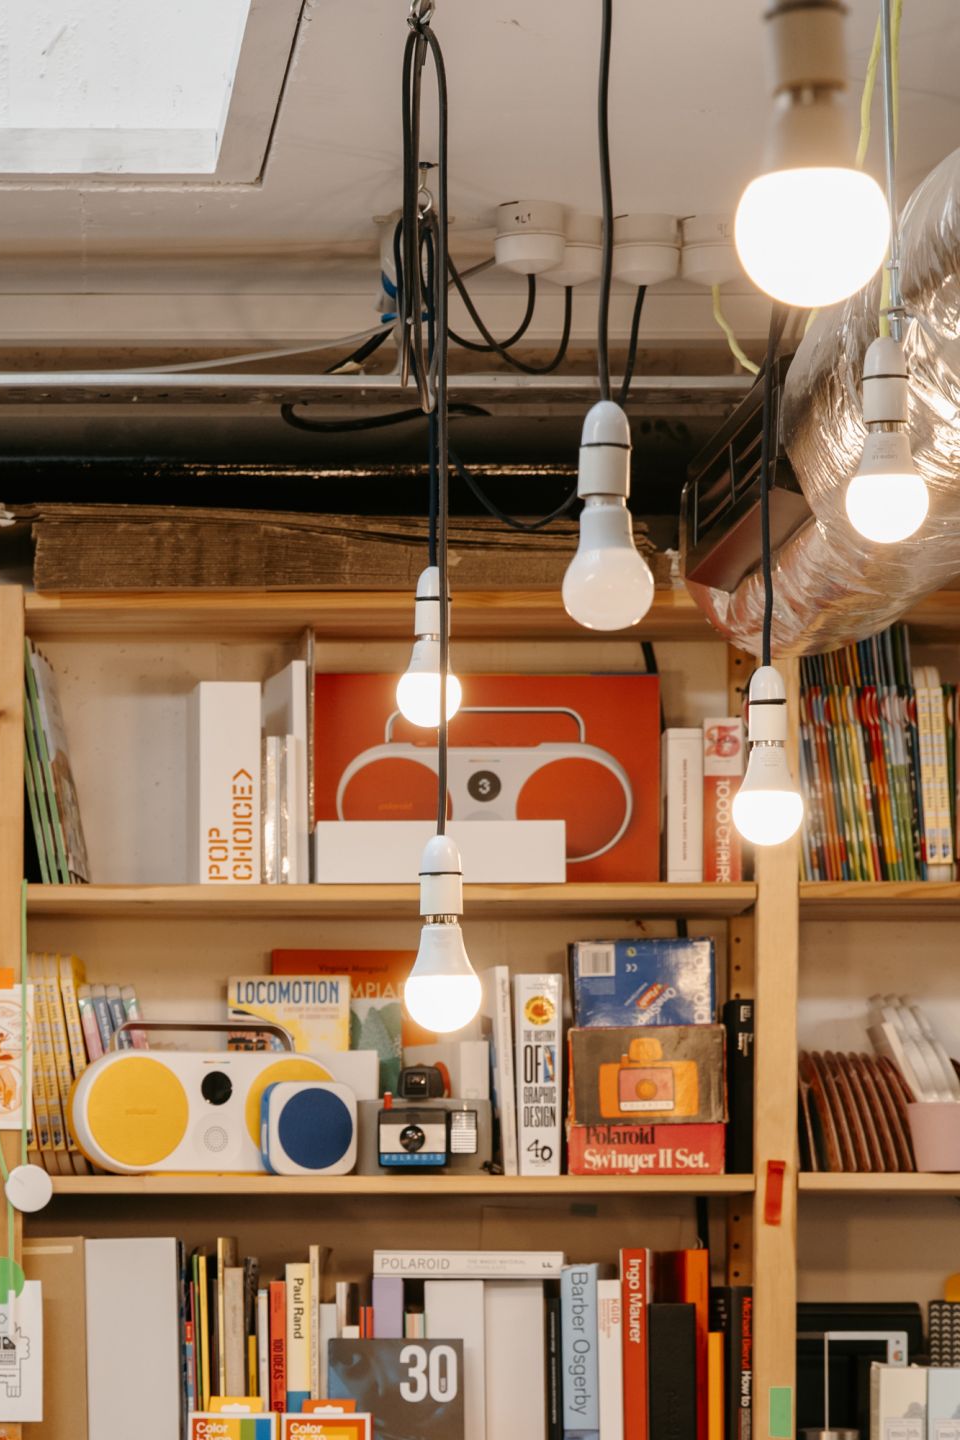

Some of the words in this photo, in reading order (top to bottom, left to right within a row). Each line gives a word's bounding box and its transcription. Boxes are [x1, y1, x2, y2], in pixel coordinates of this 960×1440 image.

[478, 778, 491, 794] 3
[715, 780, 730, 824] 1000
[208, 828, 228, 880] POP
[236, 980, 339, 1004] LOCOMOTION
[524, 1045, 541, 1083] OF
[524, 1087, 556, 1104] GRAPHIC
[524, 1106, 556, 1127] DESIGN
[586, 1126, 655, 1145] Polaroid
[584, 1148, 656, 1172] Swinger
[659, 1148, 672, 1168] II
[675, 1148, 710, 1168] Set.
[381, 1258, 451, 1270] POLAROID
[626, 1259, 642, 1289] Ingo
[293, 1278, 304, 1304] Paul
[570, 1272, 589, 1334] Barber
[293, 1308, 304, 1339] Rand
[610, 1298, 620, 1324] KGID
[628, 1293, 642, 1343] Maurer
[741, 1297, 753, 1337] Michael
[273, 1339, 283, 1352] 100
[273, 1354, 283, 1379] IDEAS
[399, 1344, 458, 1403] 30
[569, 1339, 591, 1415] Osgerby
[741, 1370, 752, 1395] How
[741, 1395, 751, 1407] to
[196, 1422, 228, 1434] Color
[290, 1423, 322, 1434] Color
